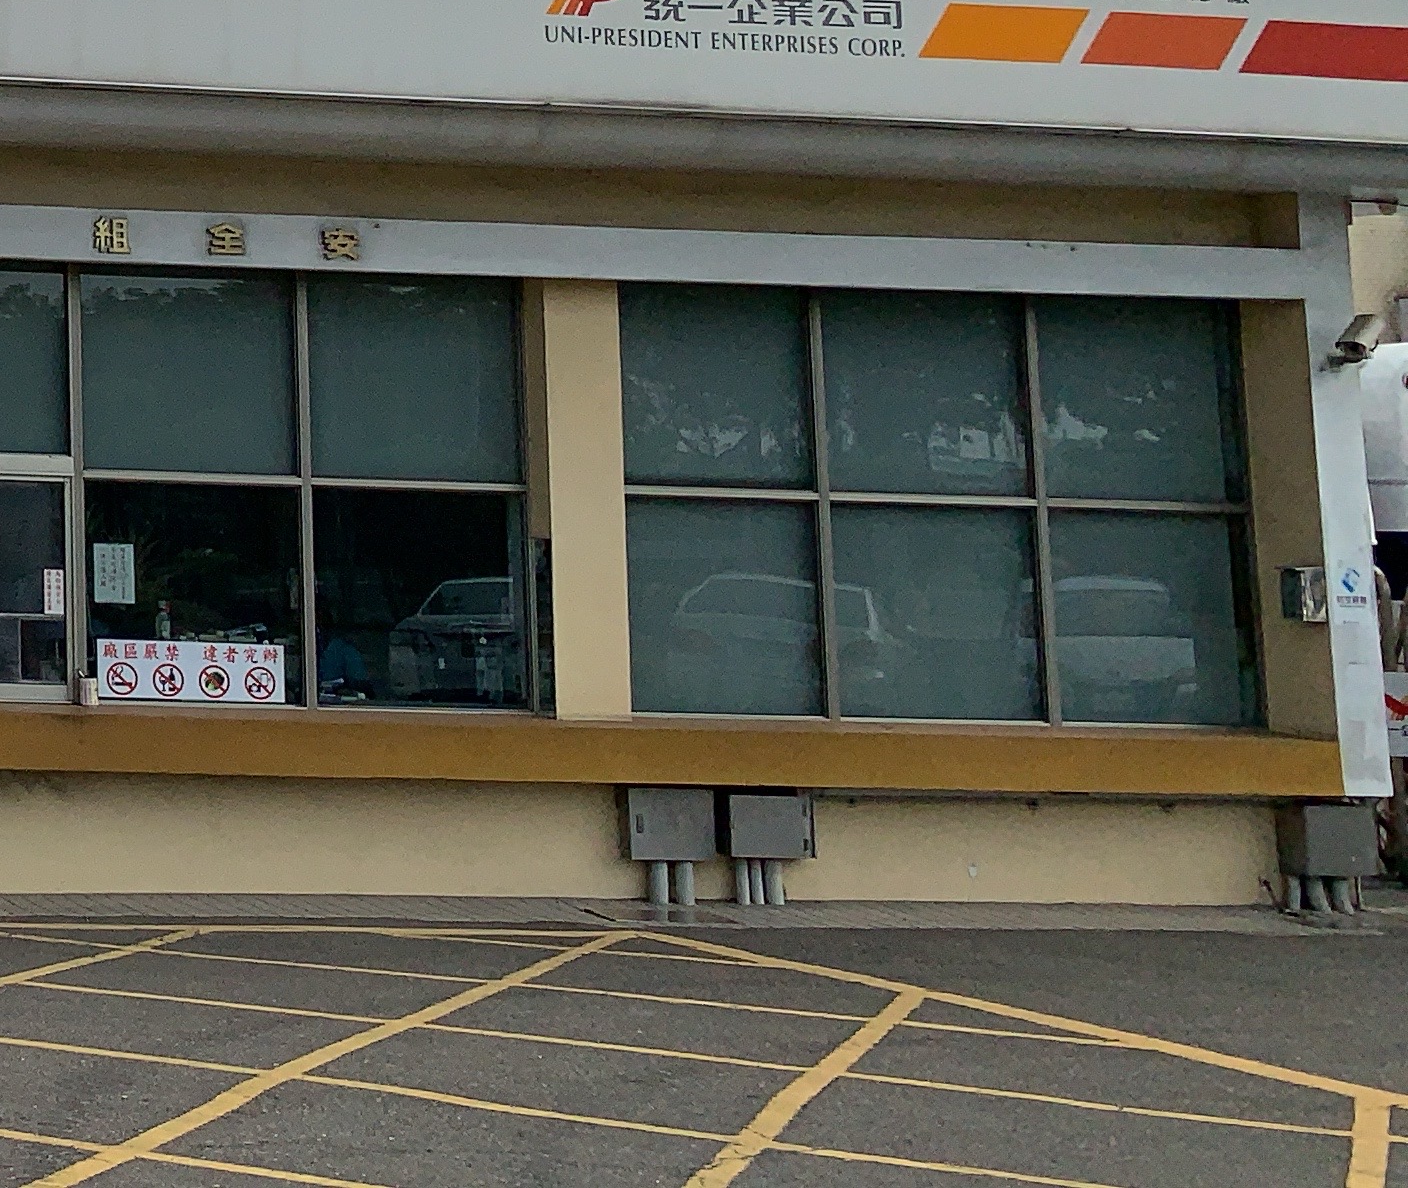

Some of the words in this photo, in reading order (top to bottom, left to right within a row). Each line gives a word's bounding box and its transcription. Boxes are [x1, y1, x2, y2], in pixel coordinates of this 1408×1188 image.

[544, 25, 702, 50] UNI-PRESIDENT
[711, 31, 839, 55] ENTERPRISES
[848, 38, 906, 58] CORP.
[102, 642, 180, 662] 廠區嚴禁
[202, 644, 279, 664] 違者究辦
